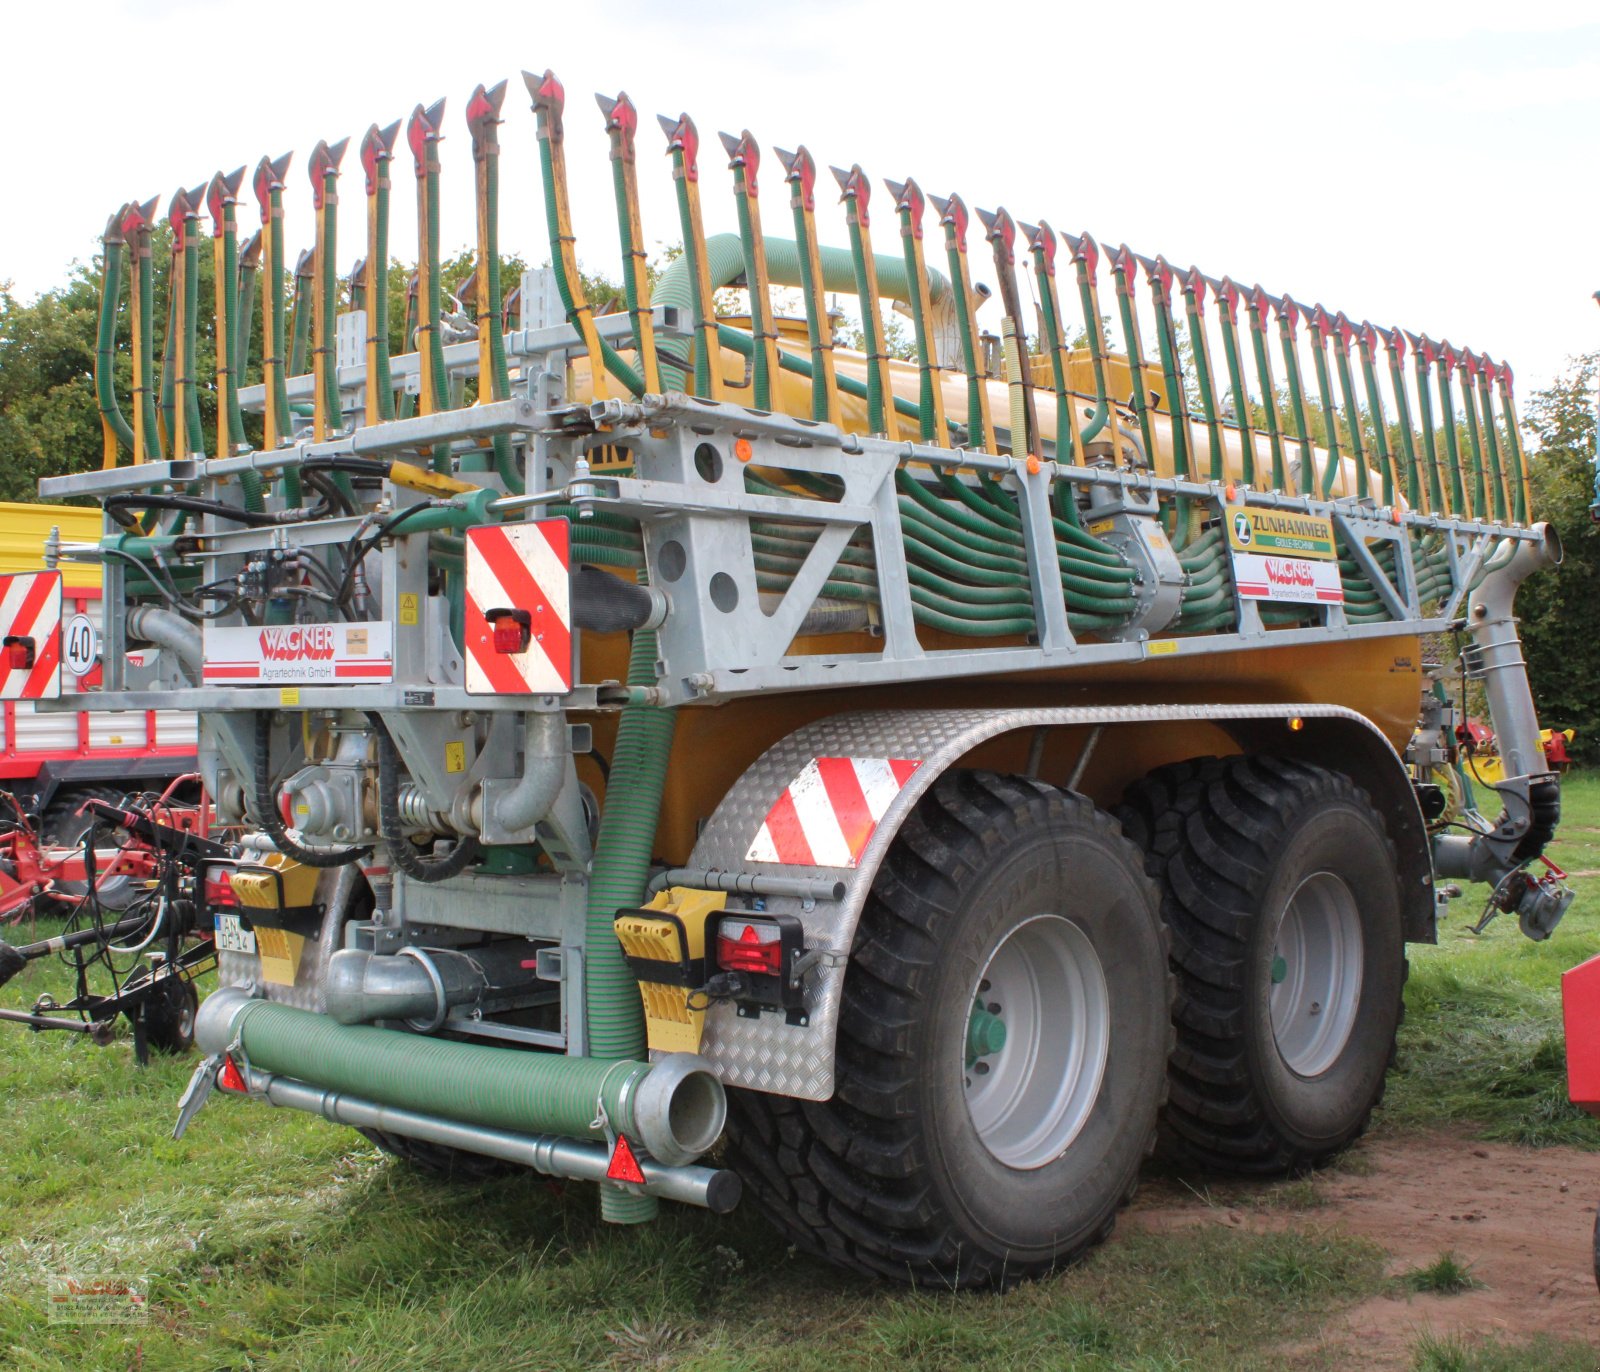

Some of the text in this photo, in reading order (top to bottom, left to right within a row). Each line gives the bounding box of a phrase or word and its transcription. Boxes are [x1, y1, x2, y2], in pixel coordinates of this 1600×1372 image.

[1252, 514, 1329, 539] ZUNHAMMER
[1265, 559, 1314, 587] WAGNER
[70, 626, 90, 662] 40
[259, 626, 336, 661] WAGNER
[263, 667, 331, 680] Agrartechnik GmbH
